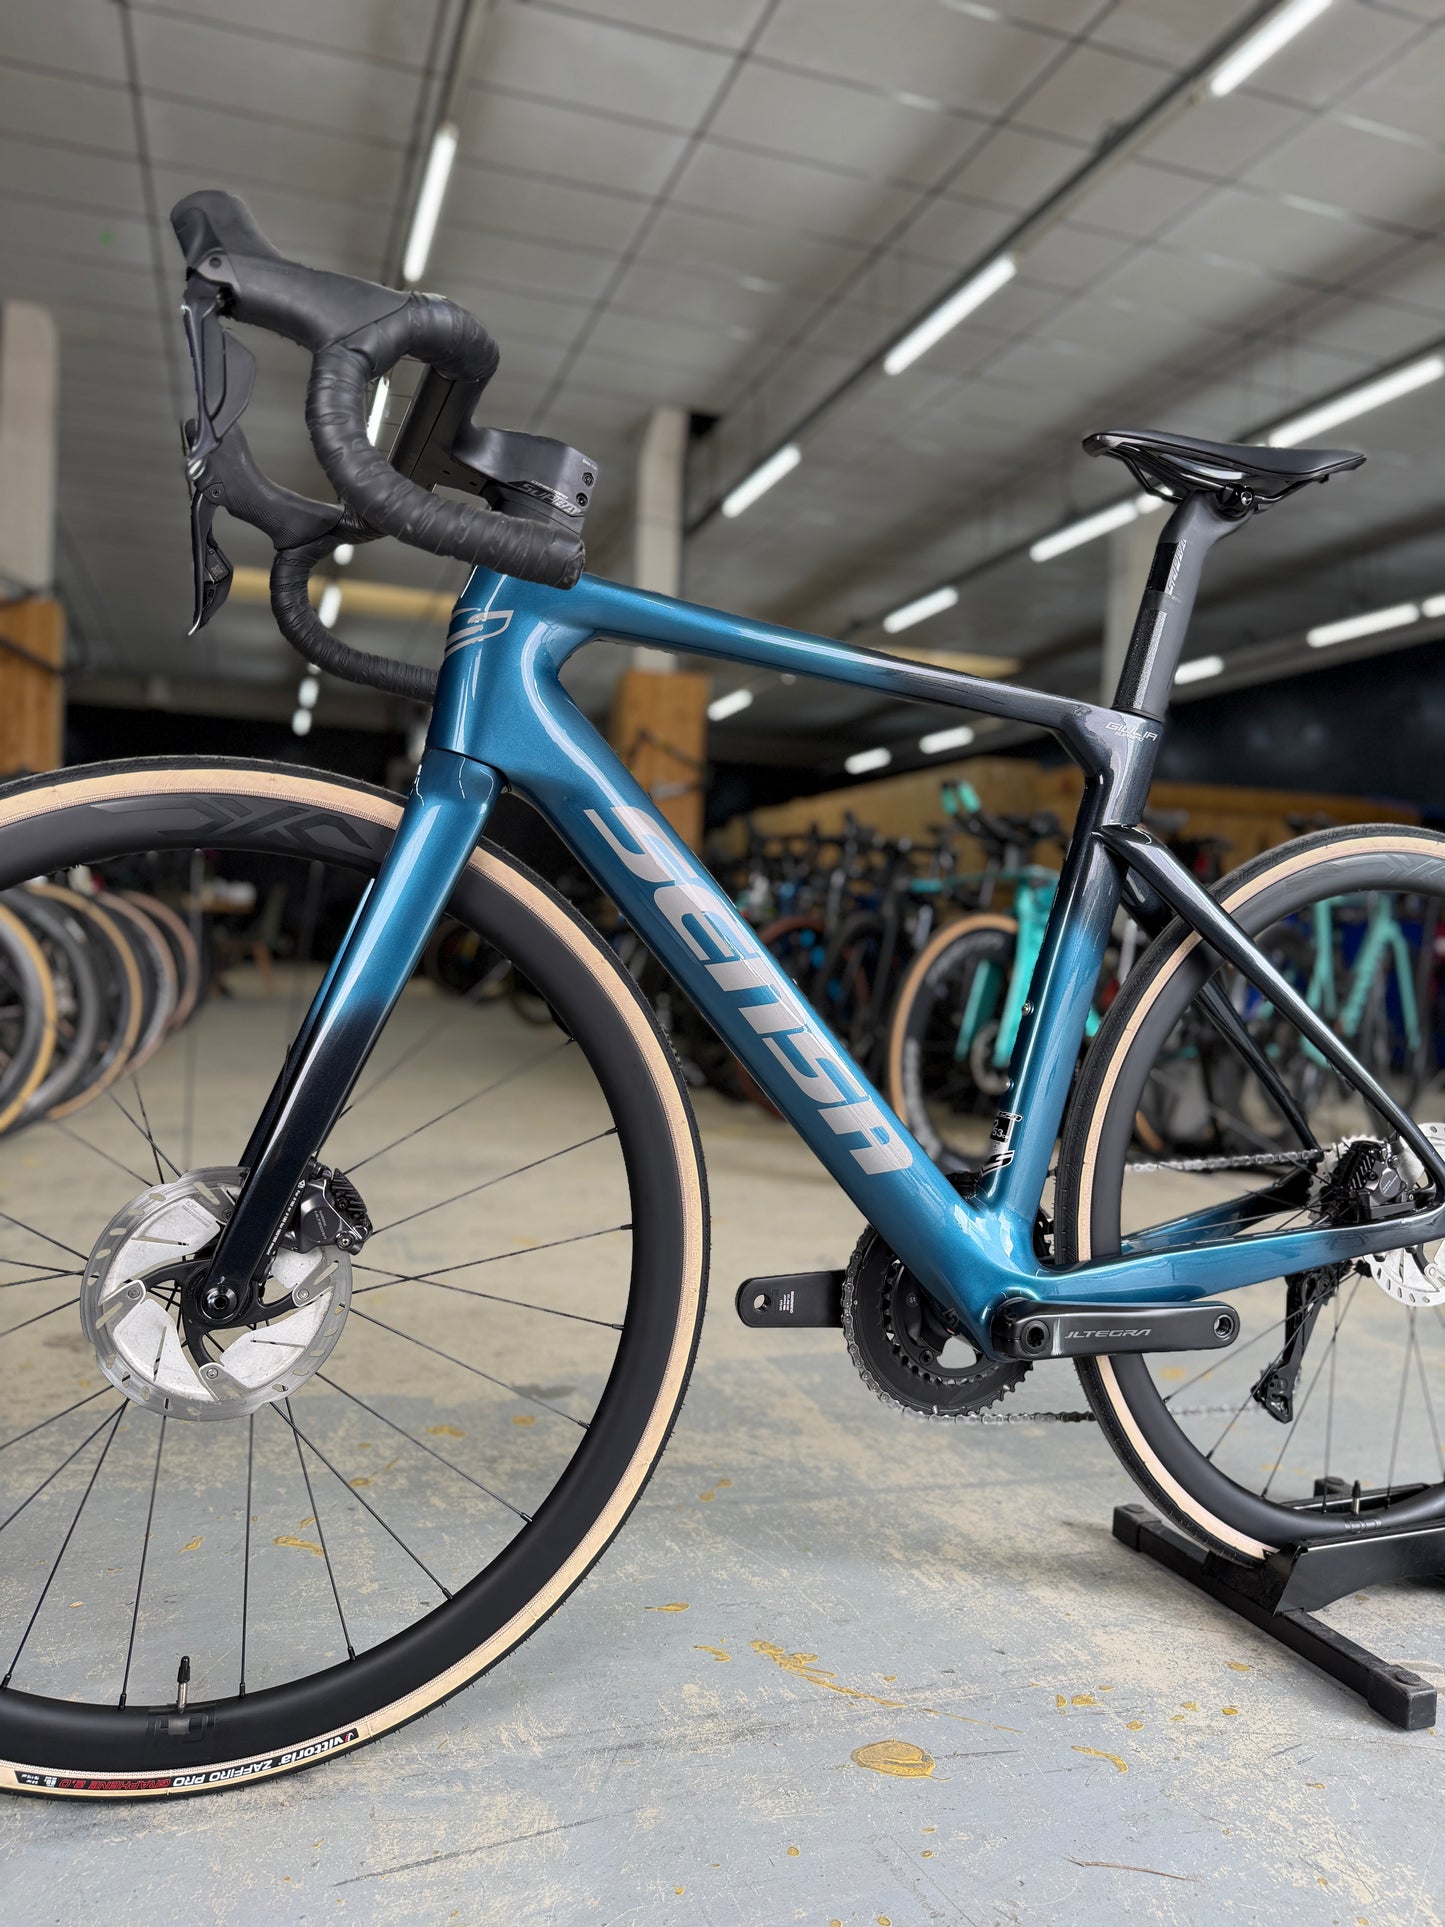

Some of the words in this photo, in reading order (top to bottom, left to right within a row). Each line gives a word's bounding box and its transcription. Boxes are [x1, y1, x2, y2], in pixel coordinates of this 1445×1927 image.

[1105, 721, 1158, 742] GIULIA
[172, 1774, 206, 1788] PRO
[208, 1760, 272, 1783] ZAFFIRO
